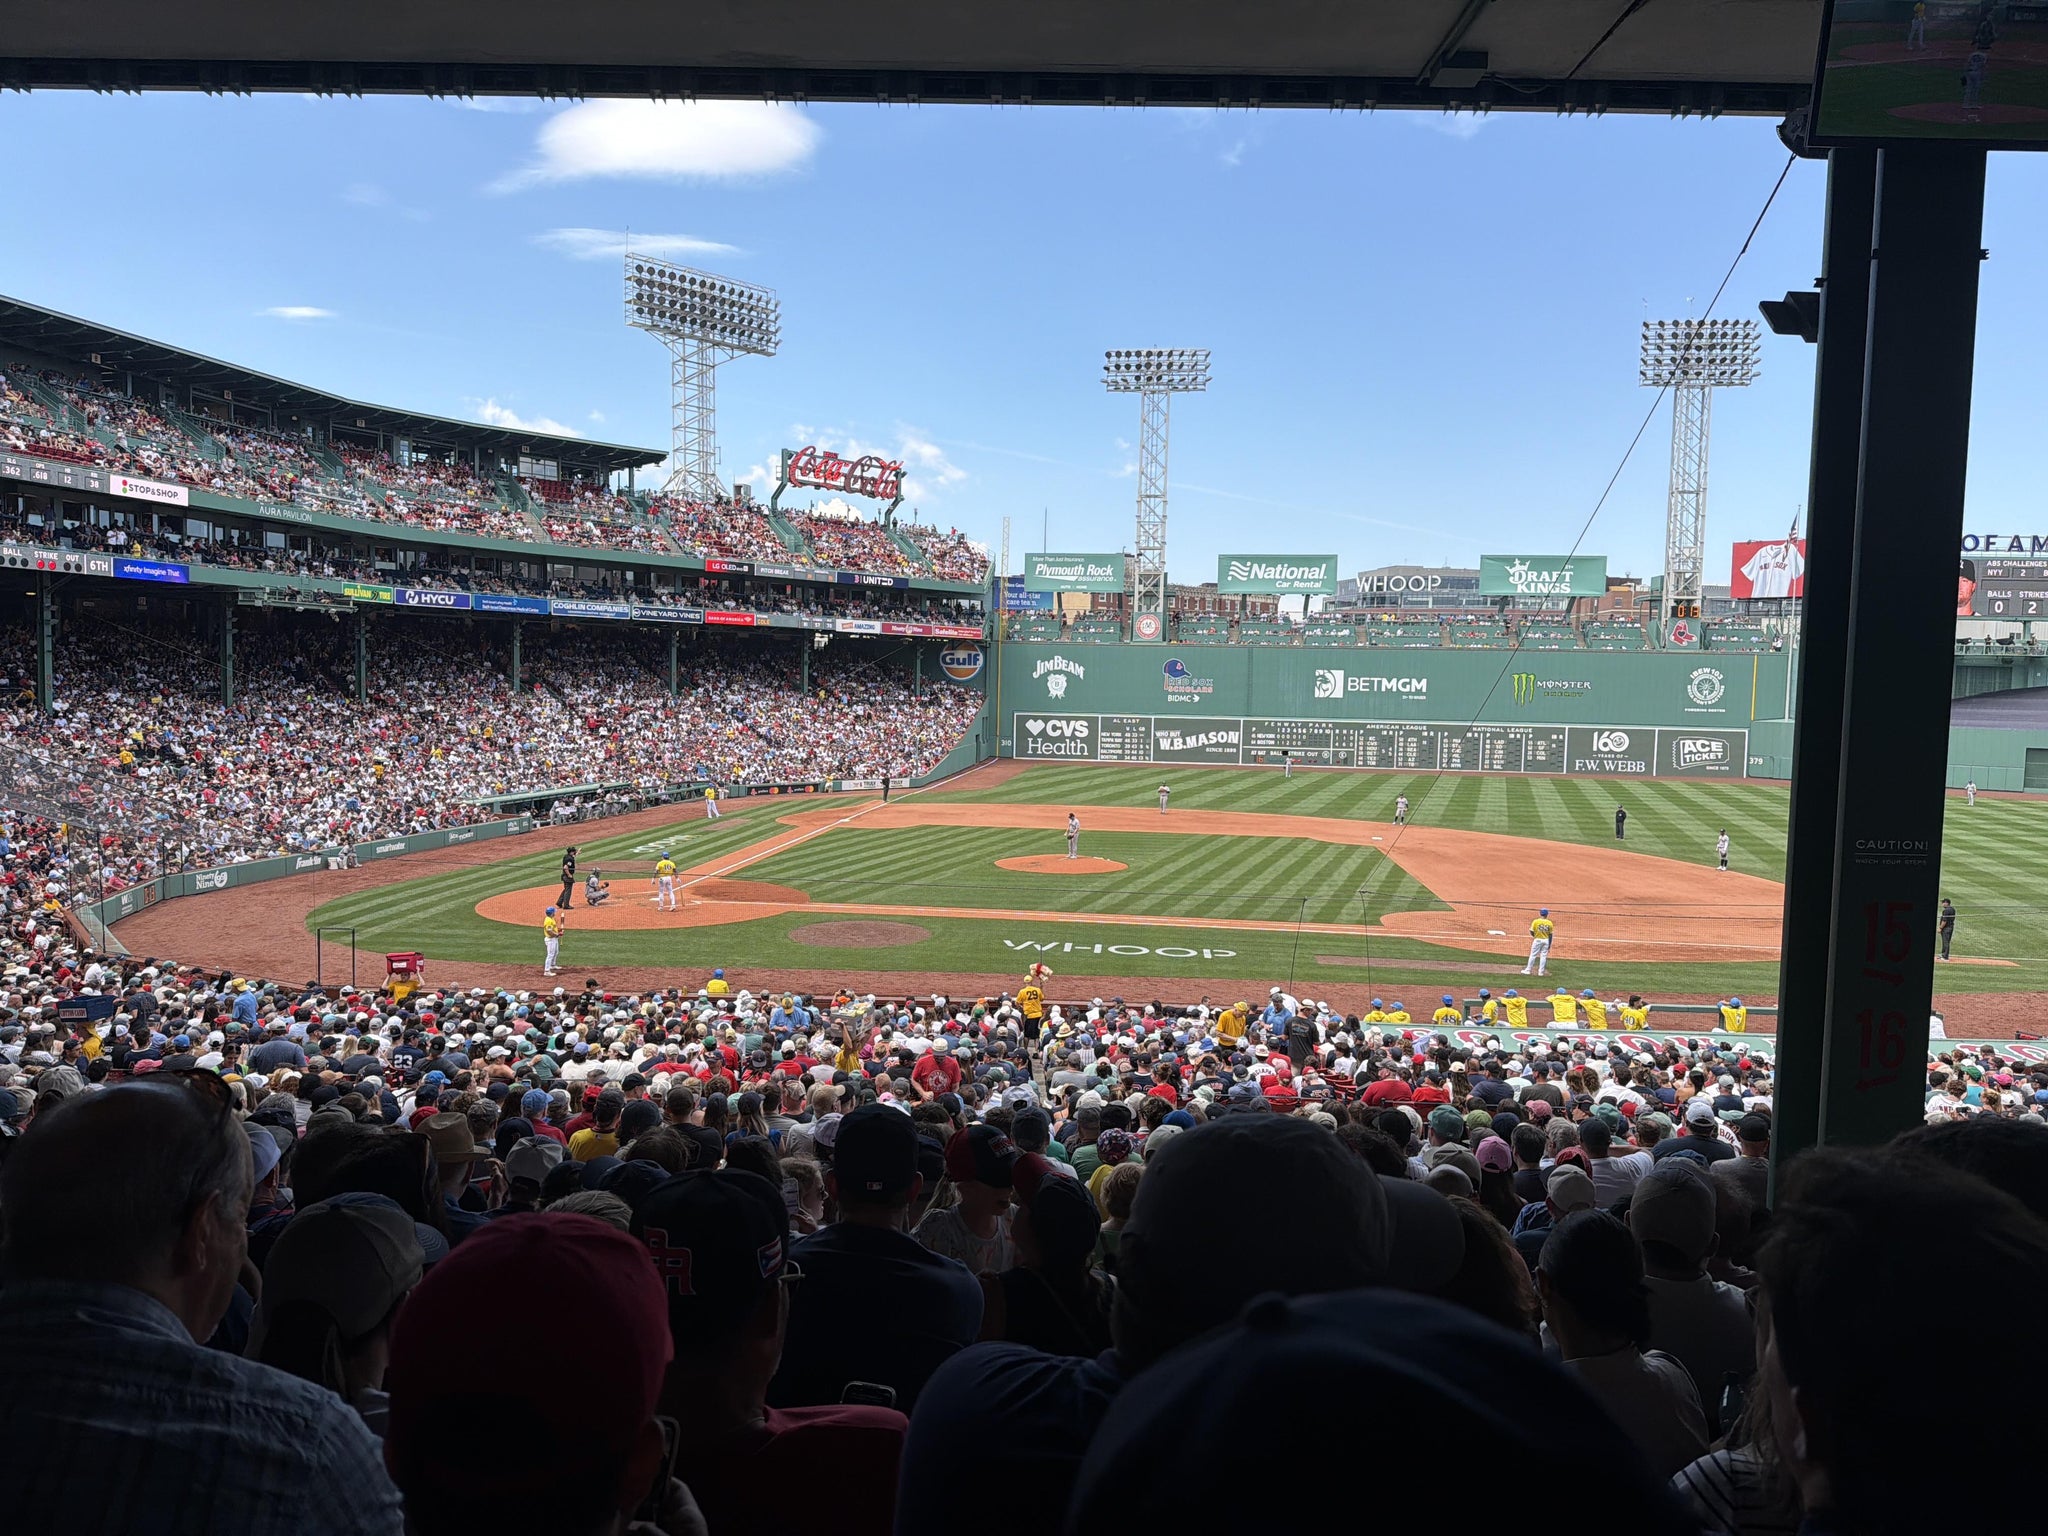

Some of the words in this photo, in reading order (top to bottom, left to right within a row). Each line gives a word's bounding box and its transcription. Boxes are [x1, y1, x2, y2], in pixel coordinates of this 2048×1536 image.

[2, 466, 20, 476] .362
[32, 470, 48, 480] .618
[64, 475, 72, 484] 12
[90, 480, 99, 488] 38
[789, 446, 904, 499] Coca-Cola
[259, 504, 281, 518] AURA
[283, 508, 312, 523] PAVILION
[3, 548, 22, 556] BALL
[34, 551, 58, 560] STRIKE
[90, 560, 108, 572] 6TH
[144, 567, 166, 577] Imagine
[1035, 564, 1084, 576] Plymouth
[1086, 564, 1114, 576] Rock
[1250, 563, 1327, 580] National
[863, 577, 893, 586] UNITED
[1510, 570, 1573, 584] DRAFT
[1356, 575, 1441, 593] WHOOP
[1517, 583, 1571, 593] KINGS
[344, 588, 371, 598] SULLIVAN
[379, 591, 391, 600] TIRE
[421, 594, 453, 605] HYCU
[553, 602, 585, 611] COGHLIN
[586, 604, 628, 613] COMPANIES
[1994, 601, 2003, 613] 0
[2028, 602, 2037, 614] 2
[641, 610, 679, 618] VINEYARD
[680, 611, 700, 619] VINES
[942, 652, 980, 666] Gulf
[1033, 659, 1054, 679] JIM
[1054, 655, 1085, 680] BEAM
[1690, 668, 1710, 679] IBEW
[1711, 669, 1723, 680] 103
[1192, 678, 1213, 687] SOX
[1348, 677, 1427, 693] BETMGM
[1046, 720, 1088, 738] CVS
[1027, 738, 1088, 756] Health
[1592, 731, 1629, 752] 160
[1683, 740, 1723, 753] ACE
[1684, 753, 1723, 764] TICKET
[1575, 760, 1600, 770] F.W.
[1604, 760, 1646, 773] WEBB
[1856, 840, 1929, 850] CAUTION!
[196, 880, 214, 889] Nine
[1003, 939, 1237, 959] WHOOP
[1026, 990, 1038, 1000] 29
[1443, 1015, 1456, 1024] 48
[394, 1054, 413, 1068] 23
